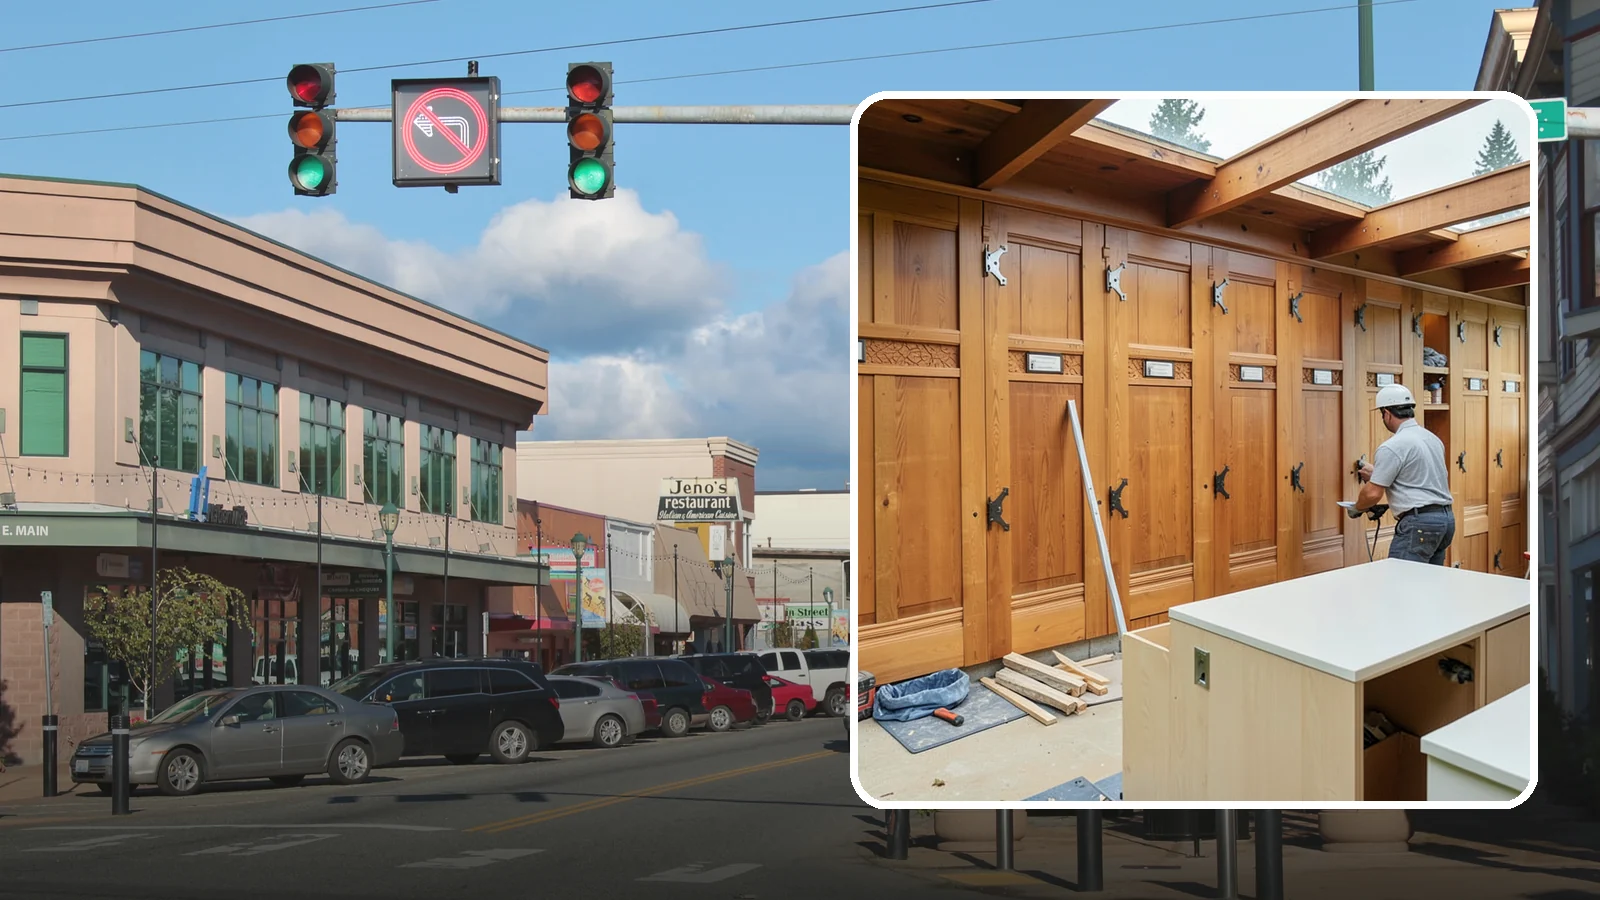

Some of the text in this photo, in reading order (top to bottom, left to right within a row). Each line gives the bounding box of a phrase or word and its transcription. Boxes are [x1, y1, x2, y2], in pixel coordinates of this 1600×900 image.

[670, 480, 727, 494] Jeno's
[665, 496, 731, 509] restaurant
[686, 510, 714, 519] American
[715, 509, 737, 519] Cuisine
[2, 525, 49, 536] E. MAIN
[797, 607, 828, 616] Street
[791, 619, 823, 627] lass
